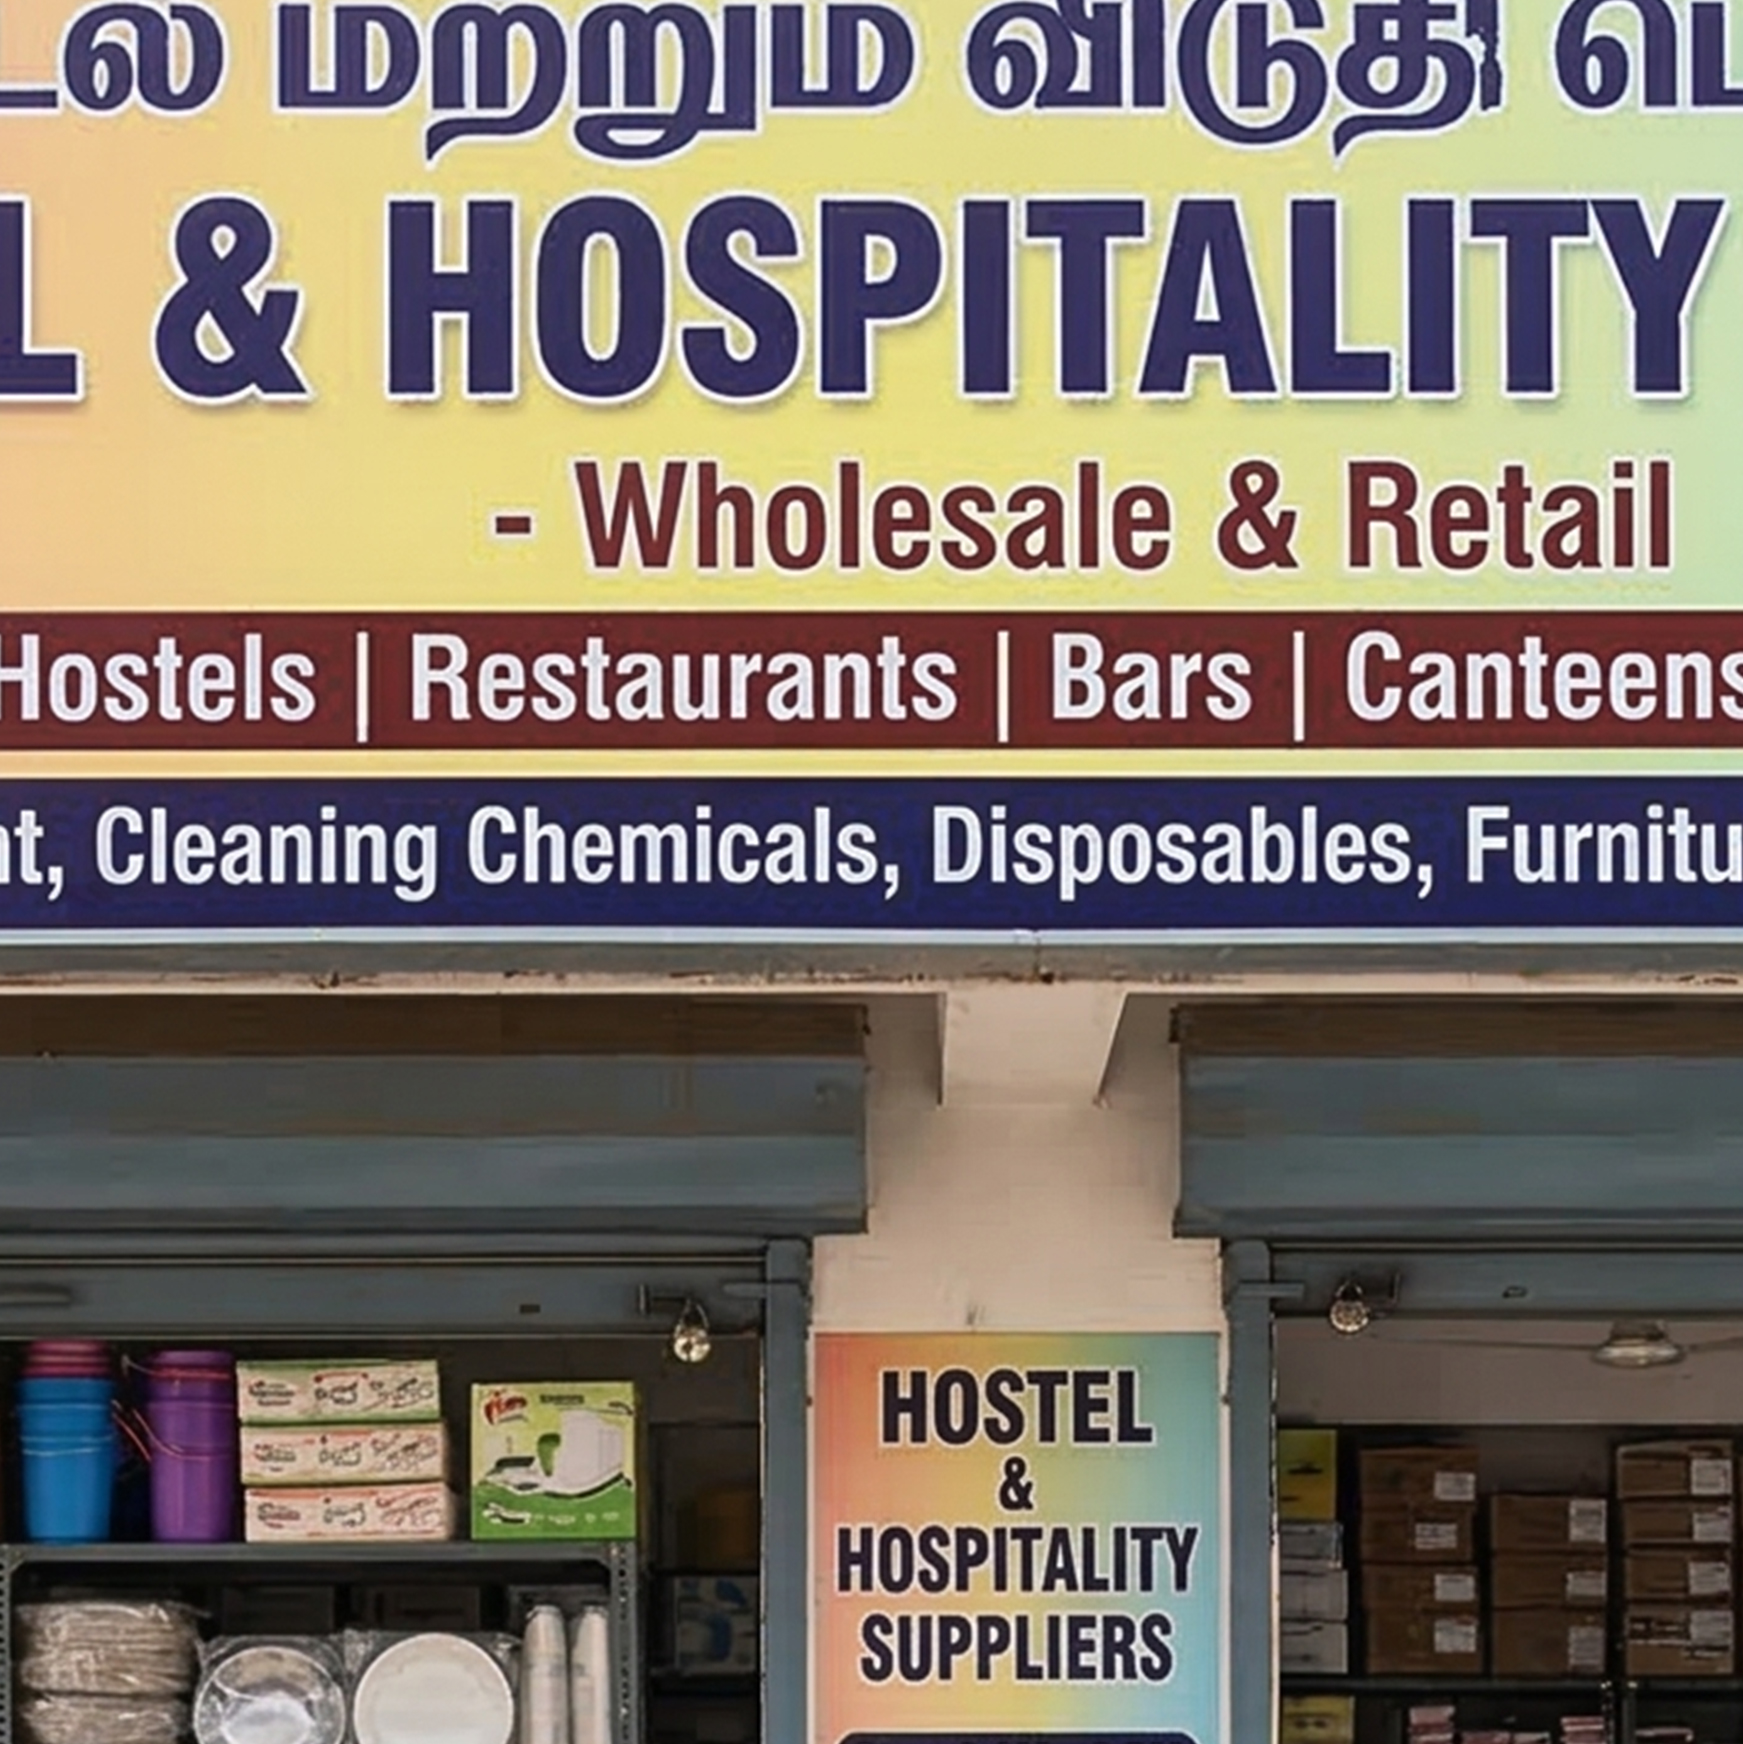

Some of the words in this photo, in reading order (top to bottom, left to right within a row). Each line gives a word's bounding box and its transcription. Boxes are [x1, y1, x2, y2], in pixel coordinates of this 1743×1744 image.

[156, 197, 307, 399] &
[388, 196, 1725, 398] HOSPITALITY
[575, 461, 1171, 571] Wholesale
[1218, 460, 1299, 571] &
[1349, 461, 1670, 570] Retail
[412, 633, 958, 722] Restaurants
[1053, 632, 1252, 721] Bars
[96, 805, 437, 902] Cleaning
[468, 804, 899, 900] Chemicals,
[933, 804, 1433, 902] Disposables,
[882, 1369, 1153, 1445] HOSTEL
[999, 1456, 1034, 1511] &
[838, 1526, 1198, 1593] HOSPITALITY
[861, 1613, 1173, 1681] SUPPLIERS
